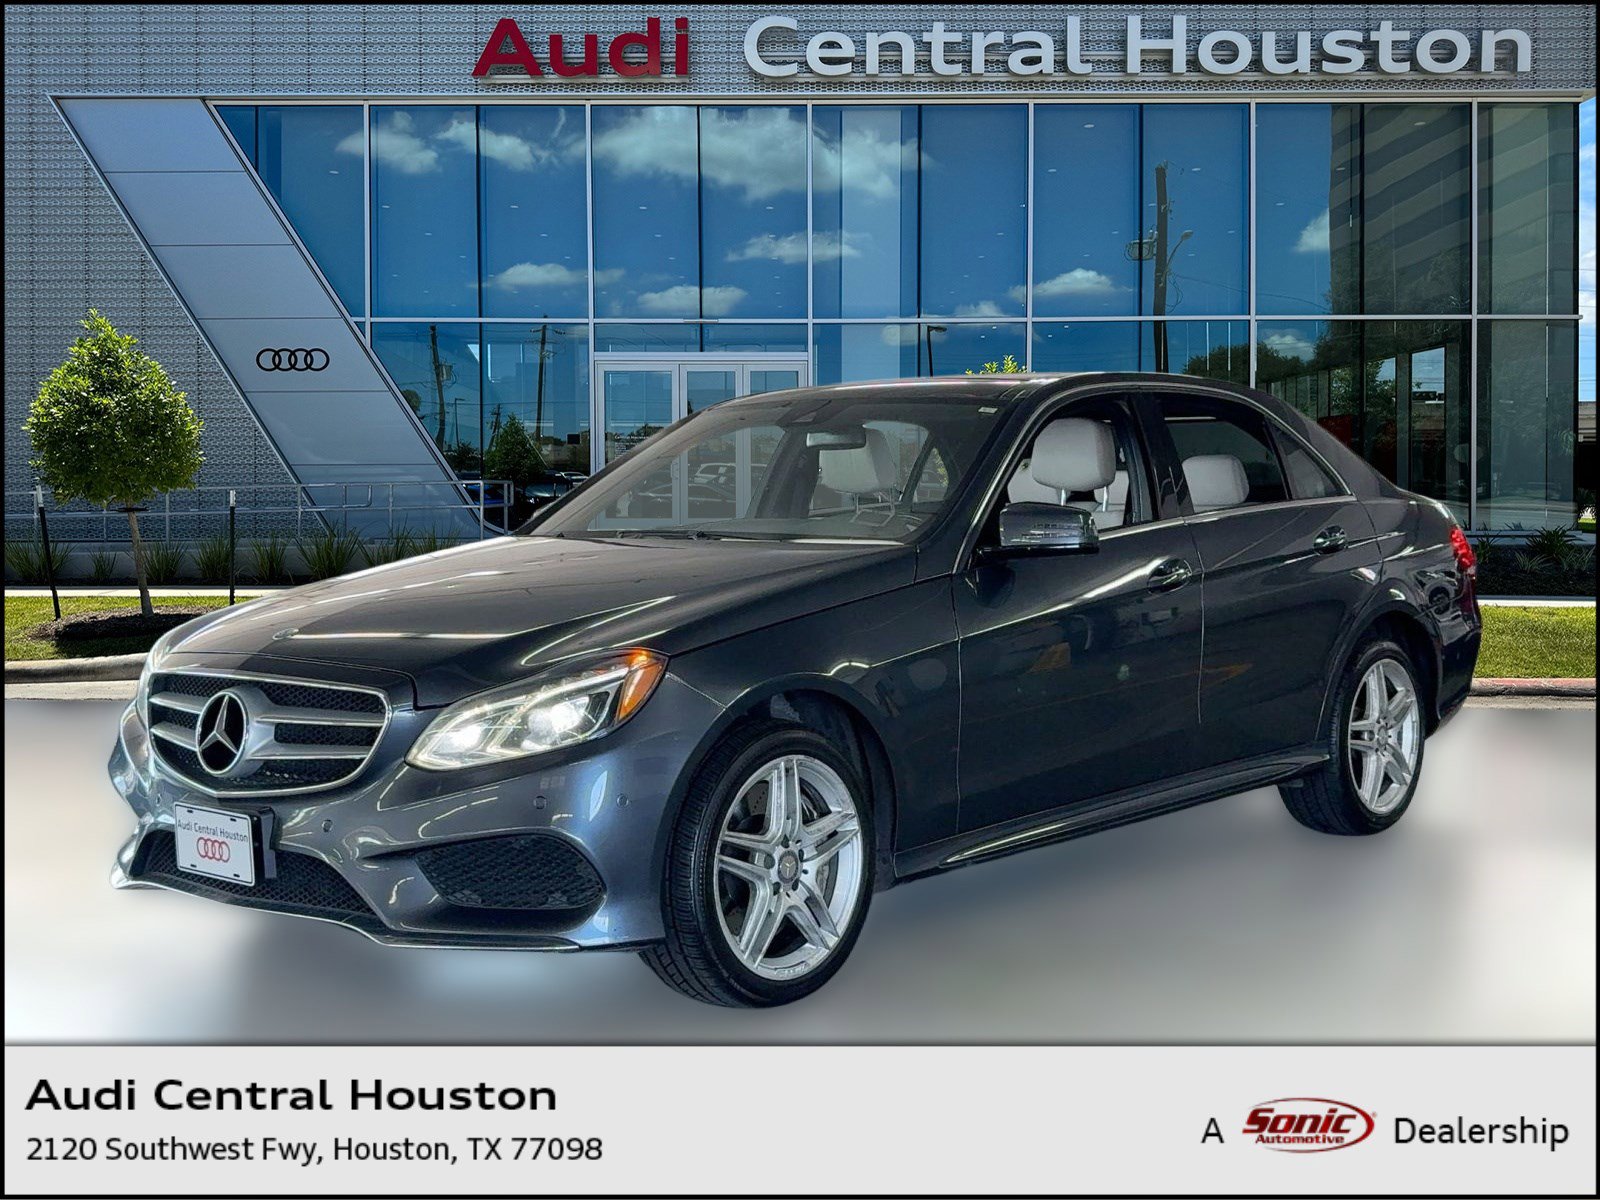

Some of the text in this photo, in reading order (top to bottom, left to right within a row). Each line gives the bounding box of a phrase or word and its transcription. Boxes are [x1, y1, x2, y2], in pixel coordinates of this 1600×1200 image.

[471, 15, 1532, 77] Audi Central Houston
[177, 819, 249, 842] Audi Central Houston
